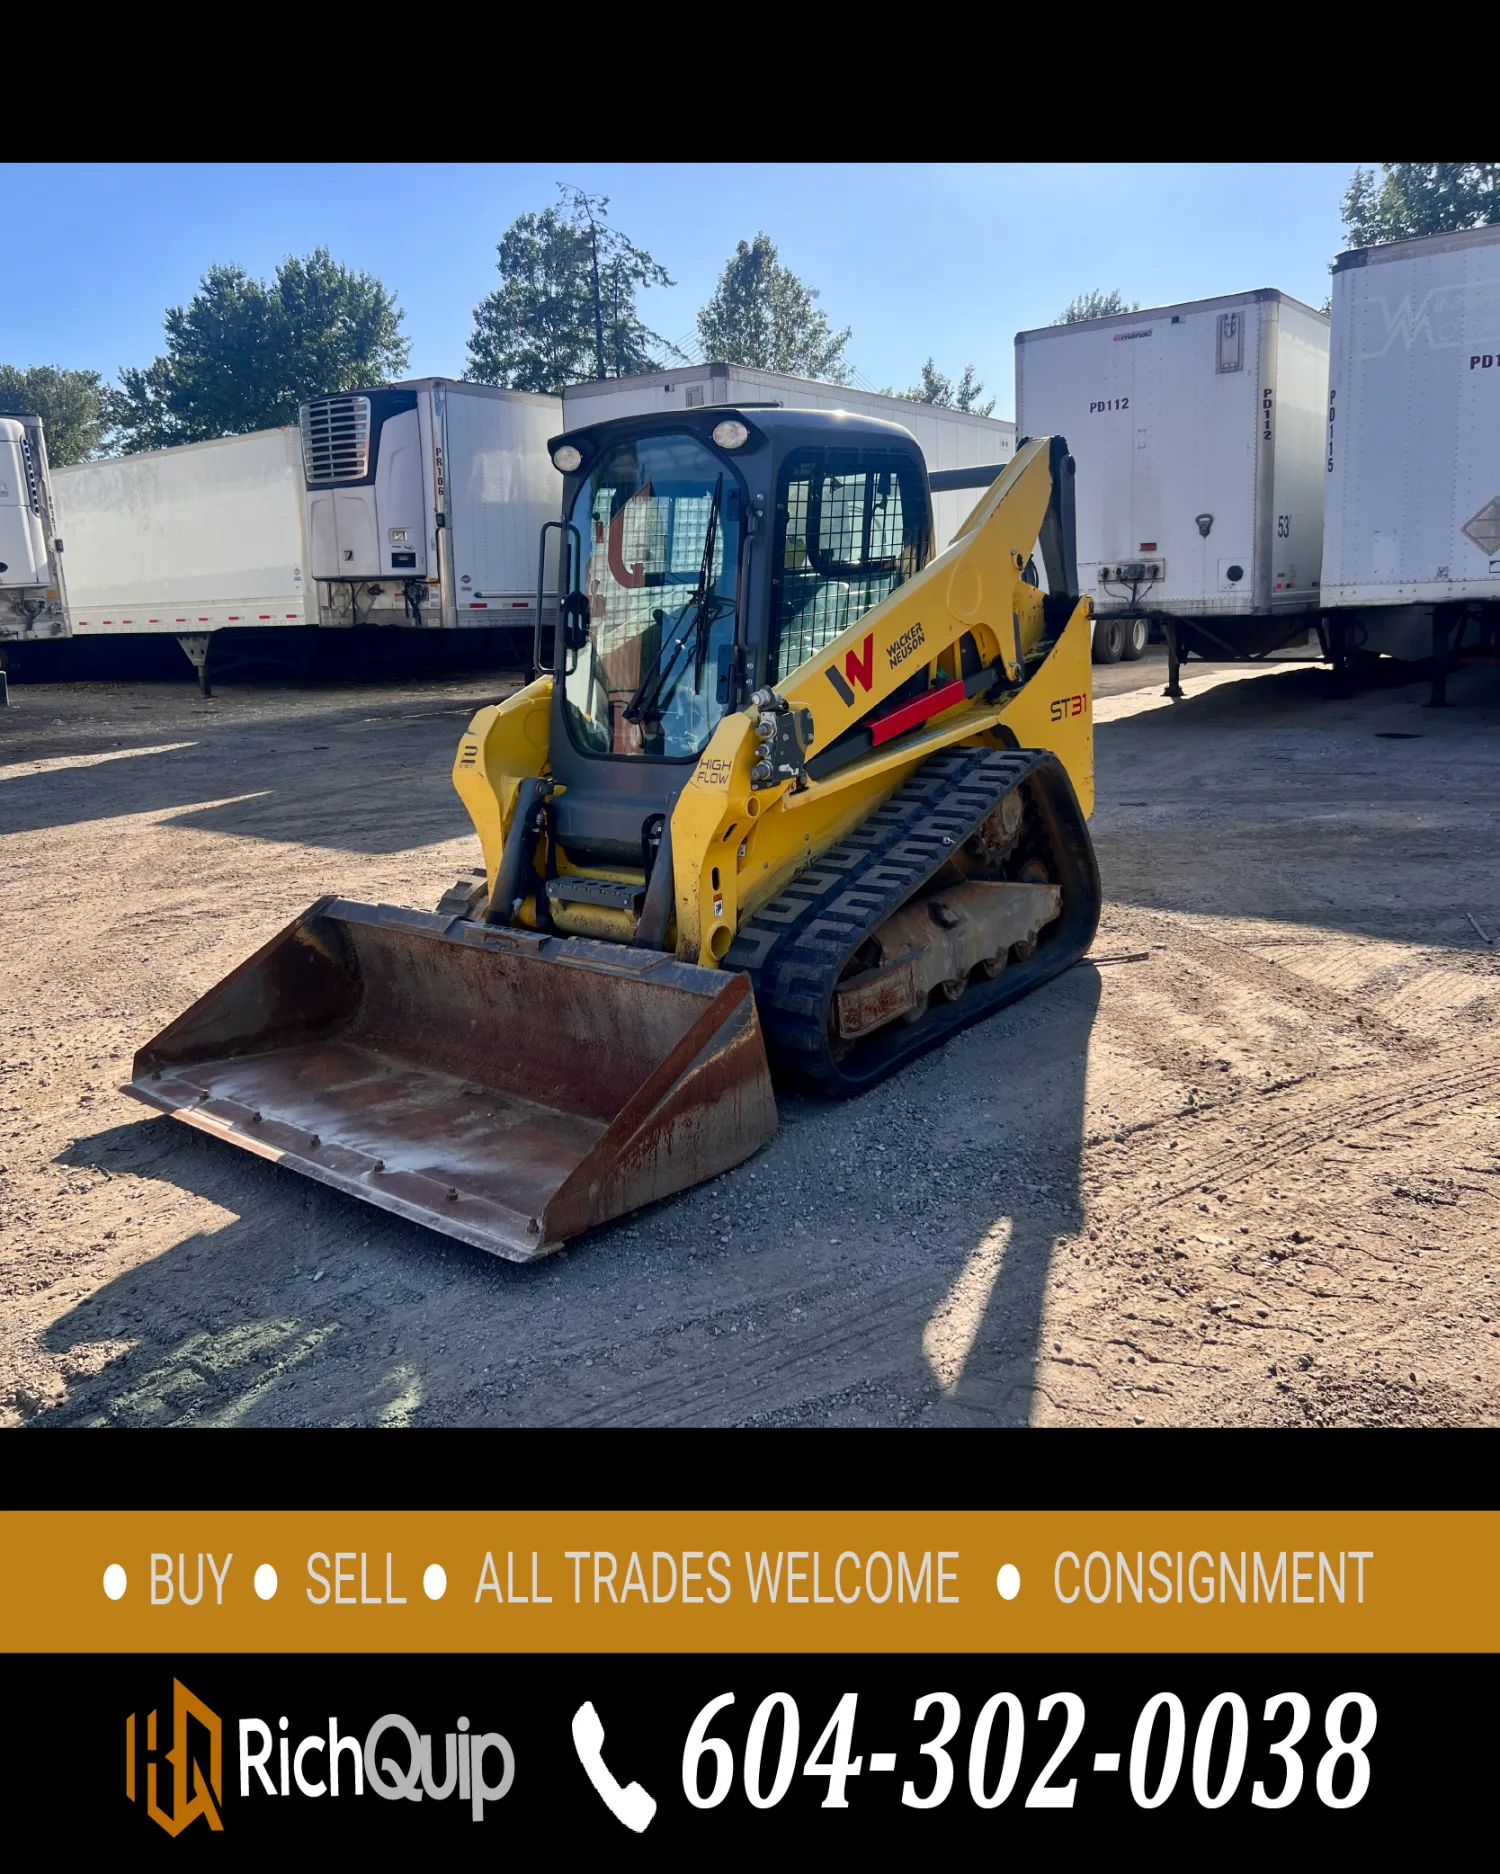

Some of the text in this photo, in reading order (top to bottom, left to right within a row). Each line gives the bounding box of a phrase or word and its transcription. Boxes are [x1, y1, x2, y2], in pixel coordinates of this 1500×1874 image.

[1089, 397, 1130, 413] PD112
[1263, 388, 1273, 441] PD112
[1327, 389, 1337, 473] PD115
[435, 447, 445, 496] PR106
[885, 621, 923, 657] WACKER
[889, 632, 926, 670] NEUSON
[1050, 692, 1087, 722] ST31
[696, 771, 729, 785] FLOW
[699, 758, 733, 771] HIGH
